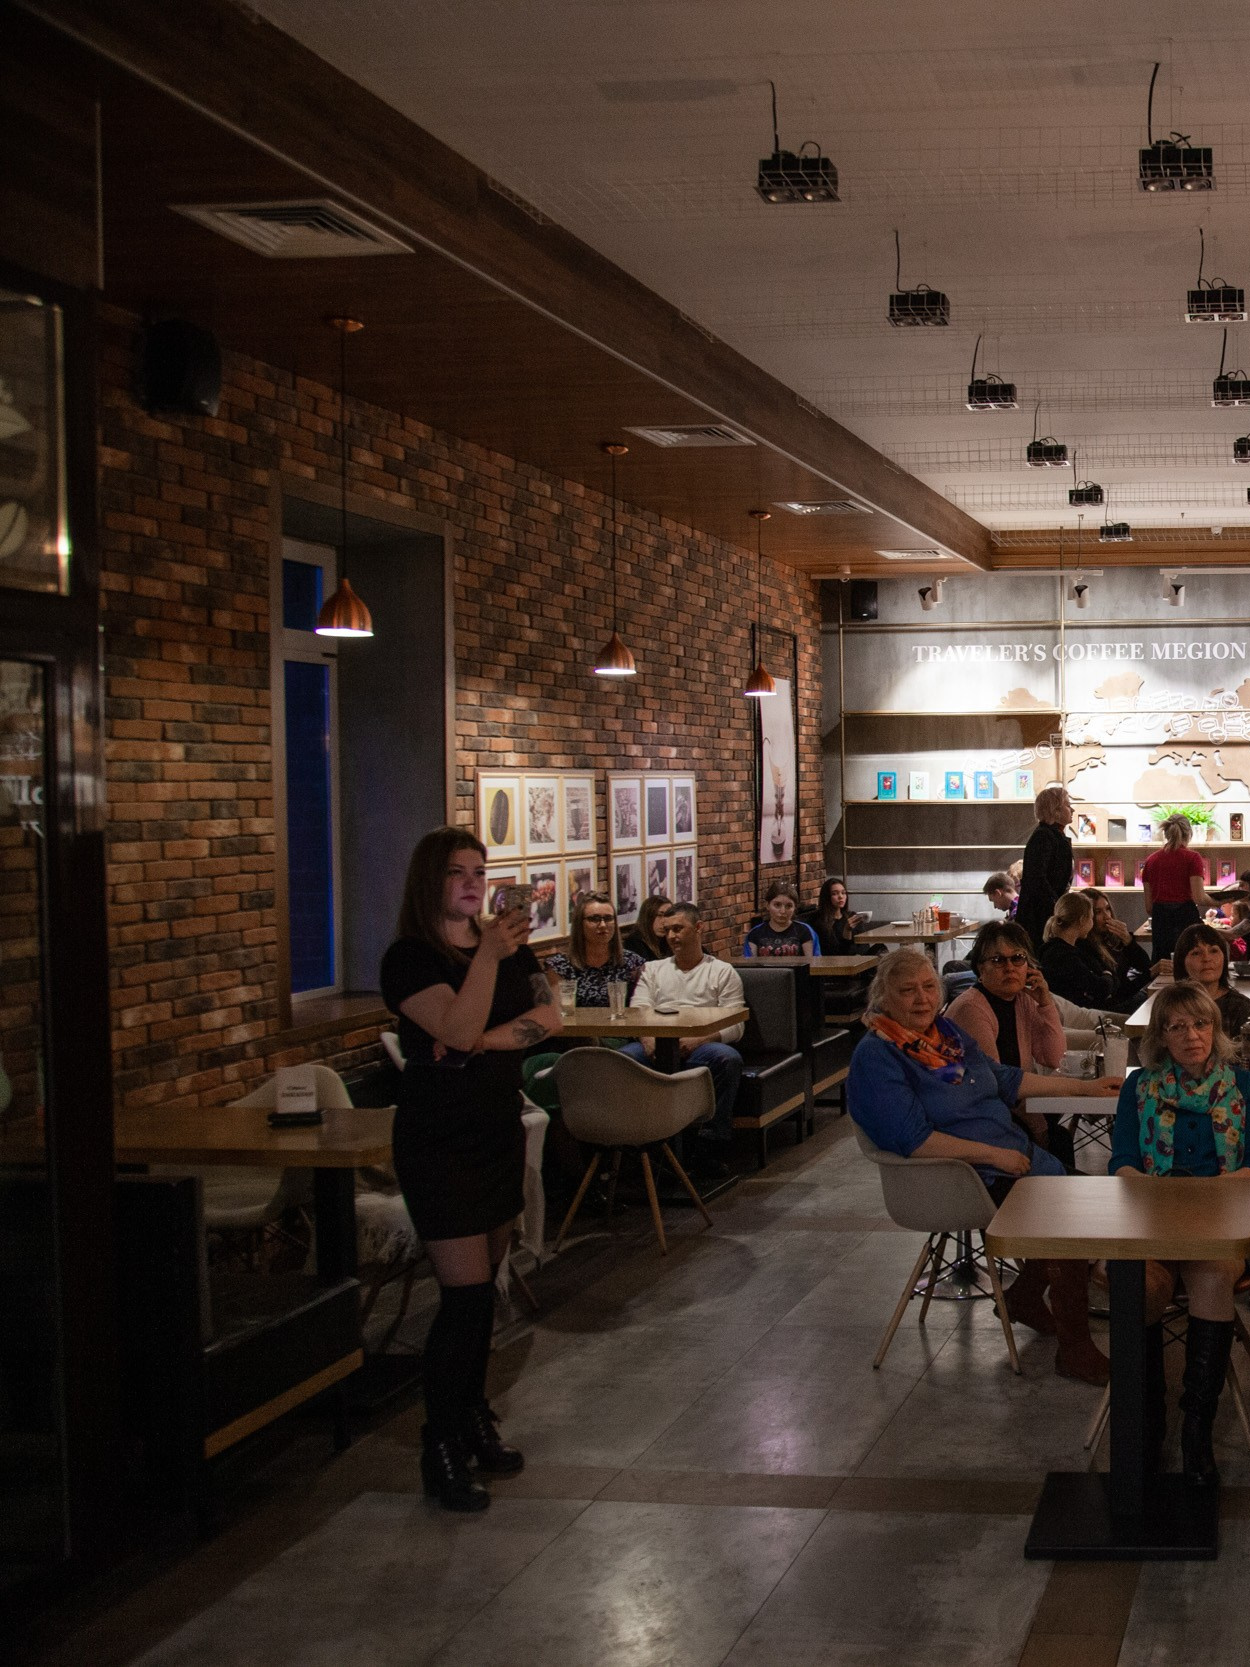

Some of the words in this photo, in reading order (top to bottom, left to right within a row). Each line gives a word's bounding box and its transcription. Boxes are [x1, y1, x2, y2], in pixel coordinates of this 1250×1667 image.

[912, 643, 1047, 663] TRAVELER'S
[1052, 642, 1144, 661] COFFEE
[1150, 641, 1247, 660] MEGION
